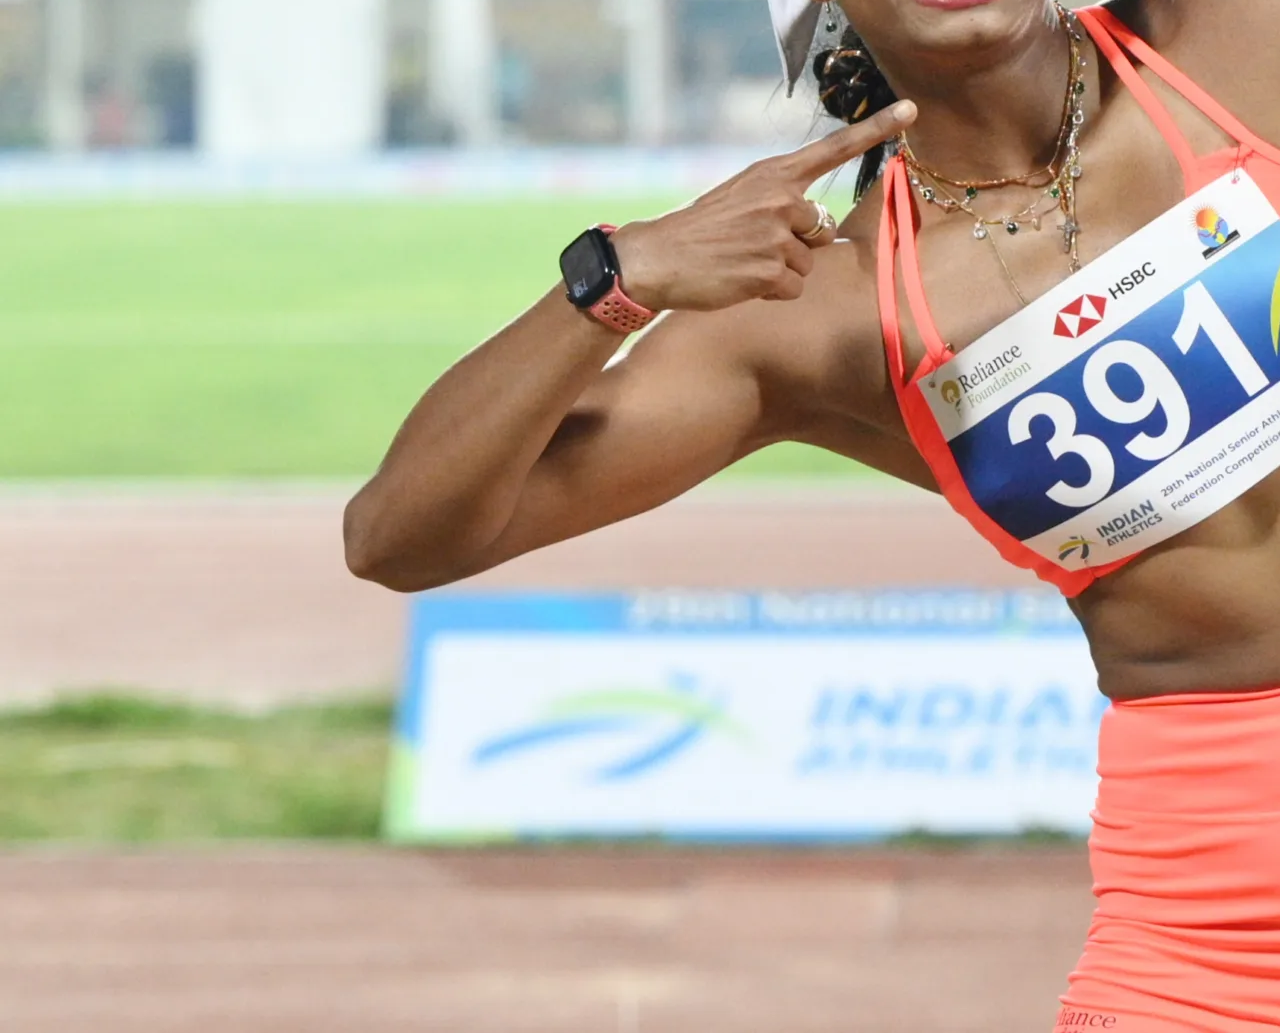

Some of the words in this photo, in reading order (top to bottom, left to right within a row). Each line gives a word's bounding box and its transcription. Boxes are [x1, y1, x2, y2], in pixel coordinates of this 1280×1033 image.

[1107, 261, 1156, 300] HSBC
[957, 345, 1022, 394] Reliance
[966, 361, 1032, 408] Foundation
[1007, 280, 1270, 507] 391
[1160, 478, 1185, 497] 29th
[1185, 449, 1228, 481] National
[1227, 428, 1260, 453] Senior
[1170, 473, 1225, 511] Federation
[1096, 499, 1155, 538] INDIAN
[1106, 513, 1163, 547] ATHLETICS
[1057, 1007, 1117, 1028] liance
